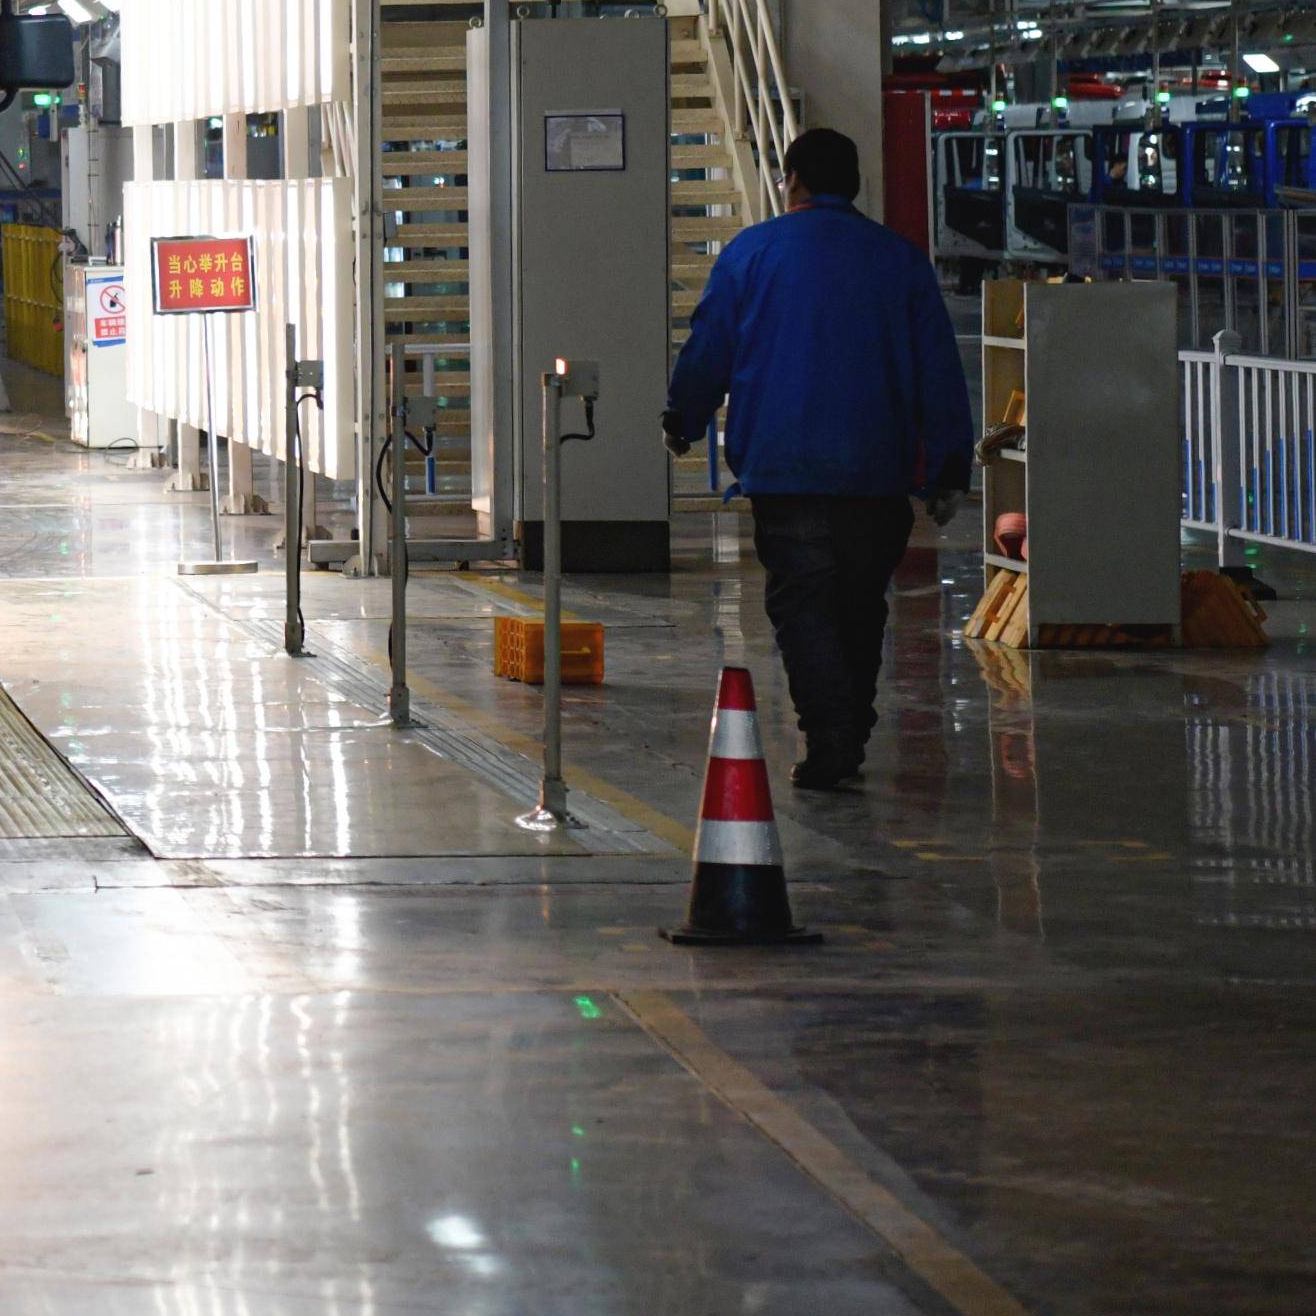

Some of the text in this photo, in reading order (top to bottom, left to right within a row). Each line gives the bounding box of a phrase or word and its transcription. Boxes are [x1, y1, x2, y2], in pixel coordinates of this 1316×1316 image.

[168, 252, 244, 275] 当心举升台
[169, 277, 245, 299] 升降动作
